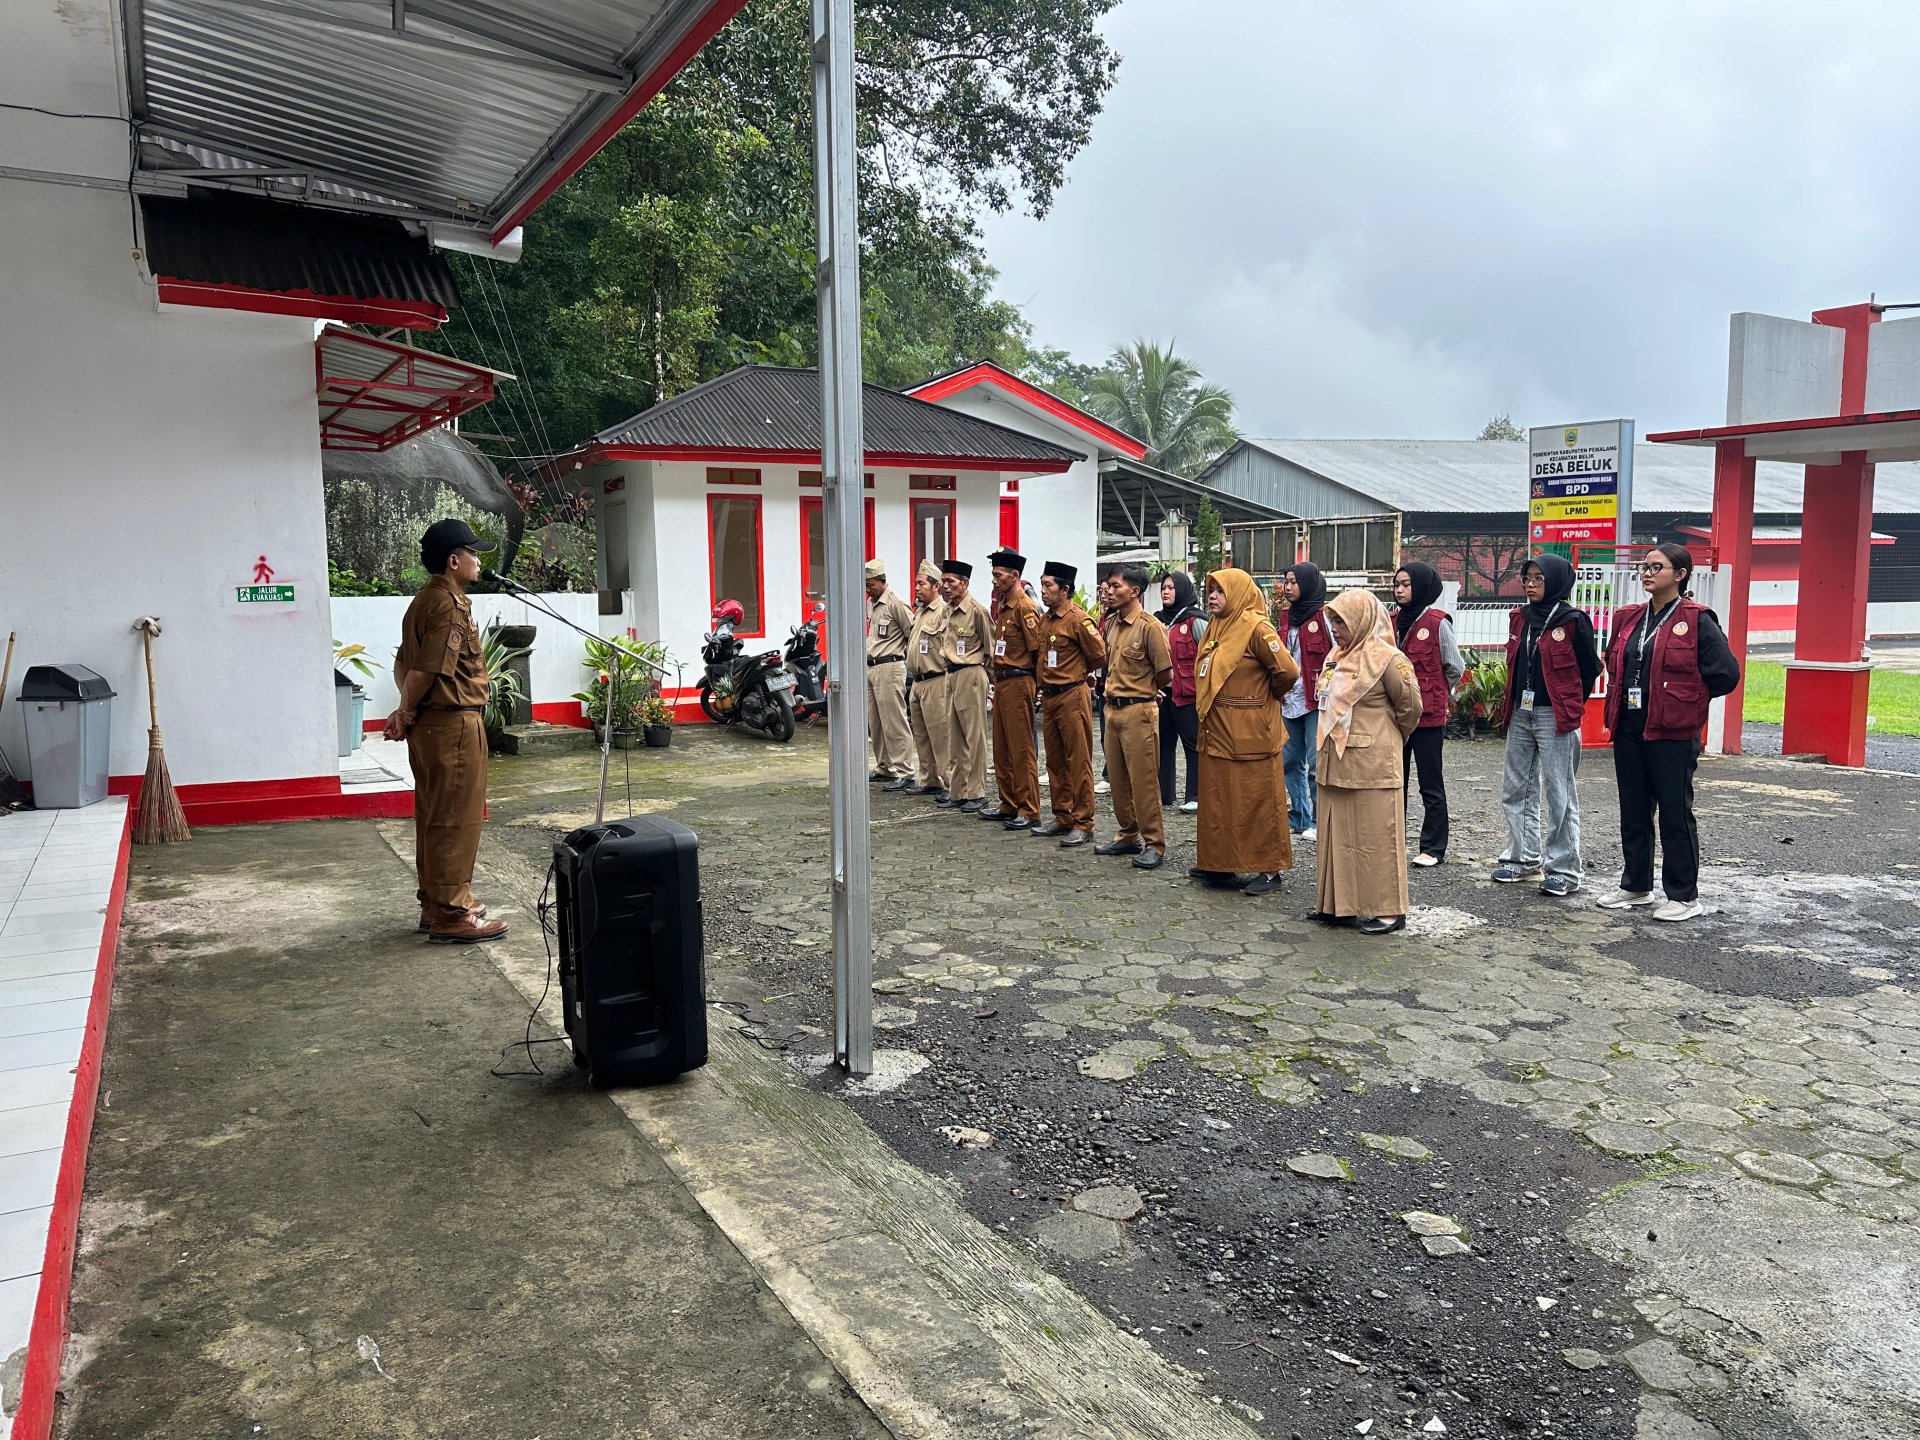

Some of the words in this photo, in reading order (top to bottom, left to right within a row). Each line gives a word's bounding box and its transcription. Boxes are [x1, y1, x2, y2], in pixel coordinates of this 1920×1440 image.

[1535, 462, 1564, 475] DESA
[1567, 458, 1613, 473] BELUK
[1565, 484, 1590, 495] BPD
[1565, 507, 1589, 515] LPMD
[1562, 530, 1591, 538] KPMD
[252, 593, 283, 601] EVAKUASI
